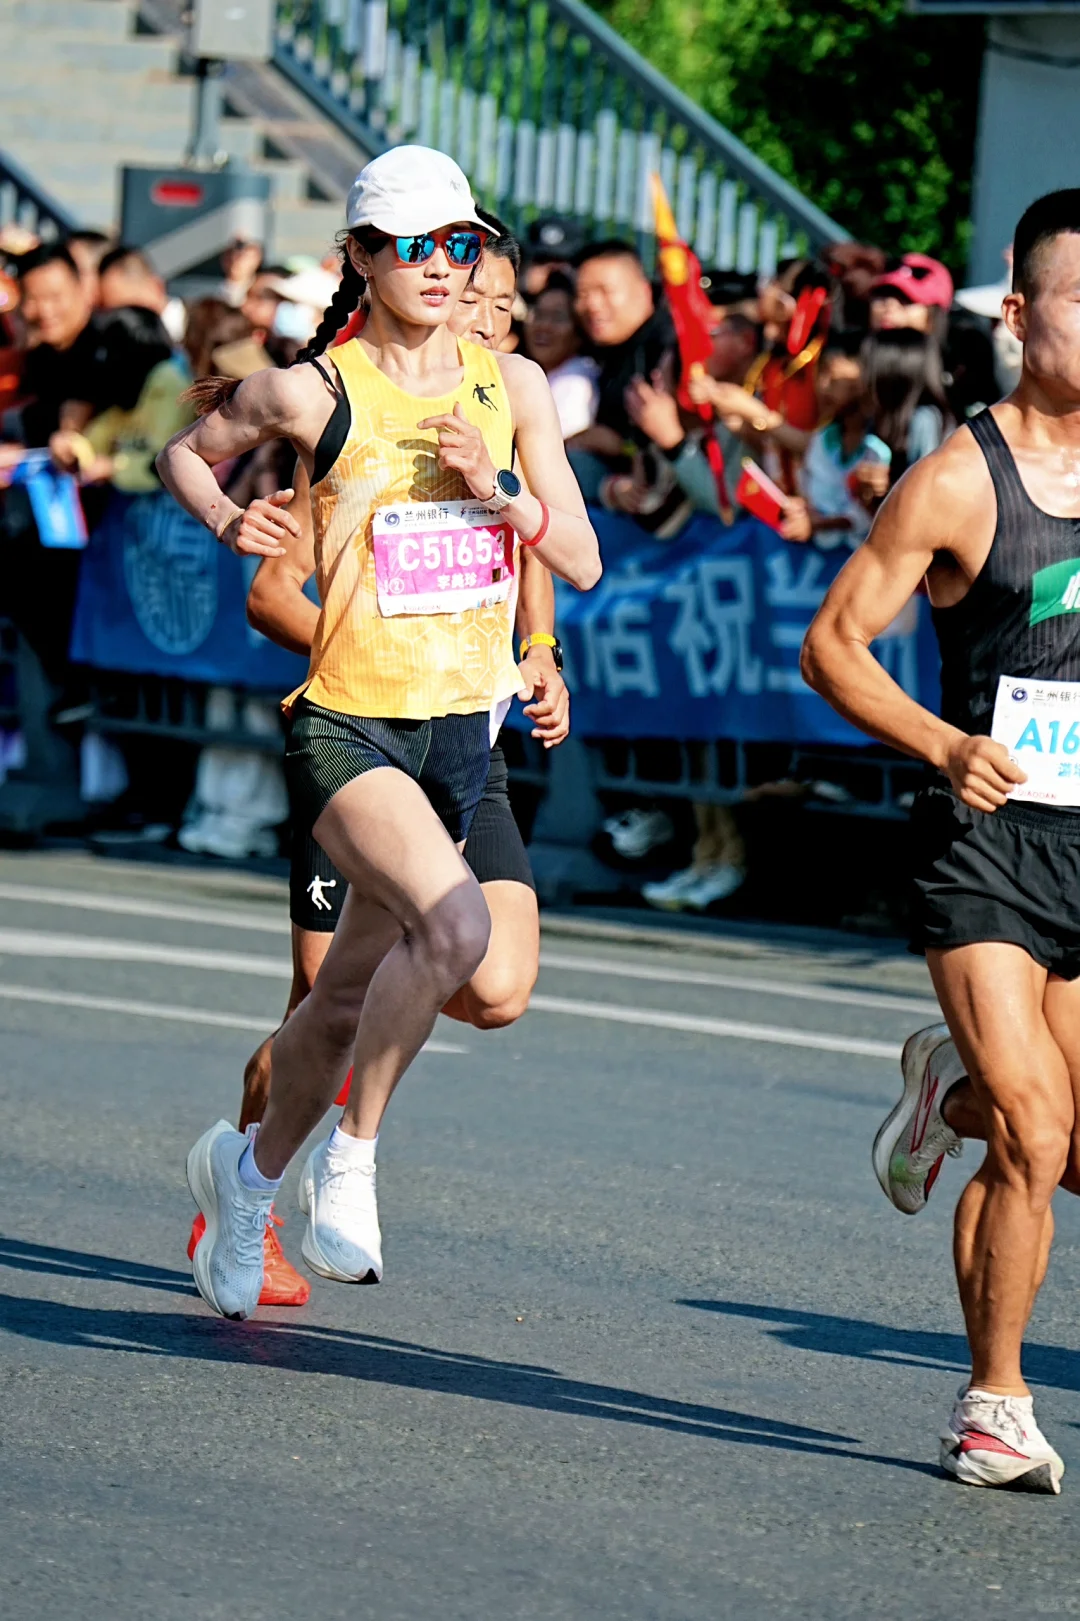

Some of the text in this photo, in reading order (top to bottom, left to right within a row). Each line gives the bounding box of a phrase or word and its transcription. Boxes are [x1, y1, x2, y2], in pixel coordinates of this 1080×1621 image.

[404, 508, 449, 521] 兰州银行
[398, 529, 505, 571] C51653
[1014, 717, 1080, 755] A16
